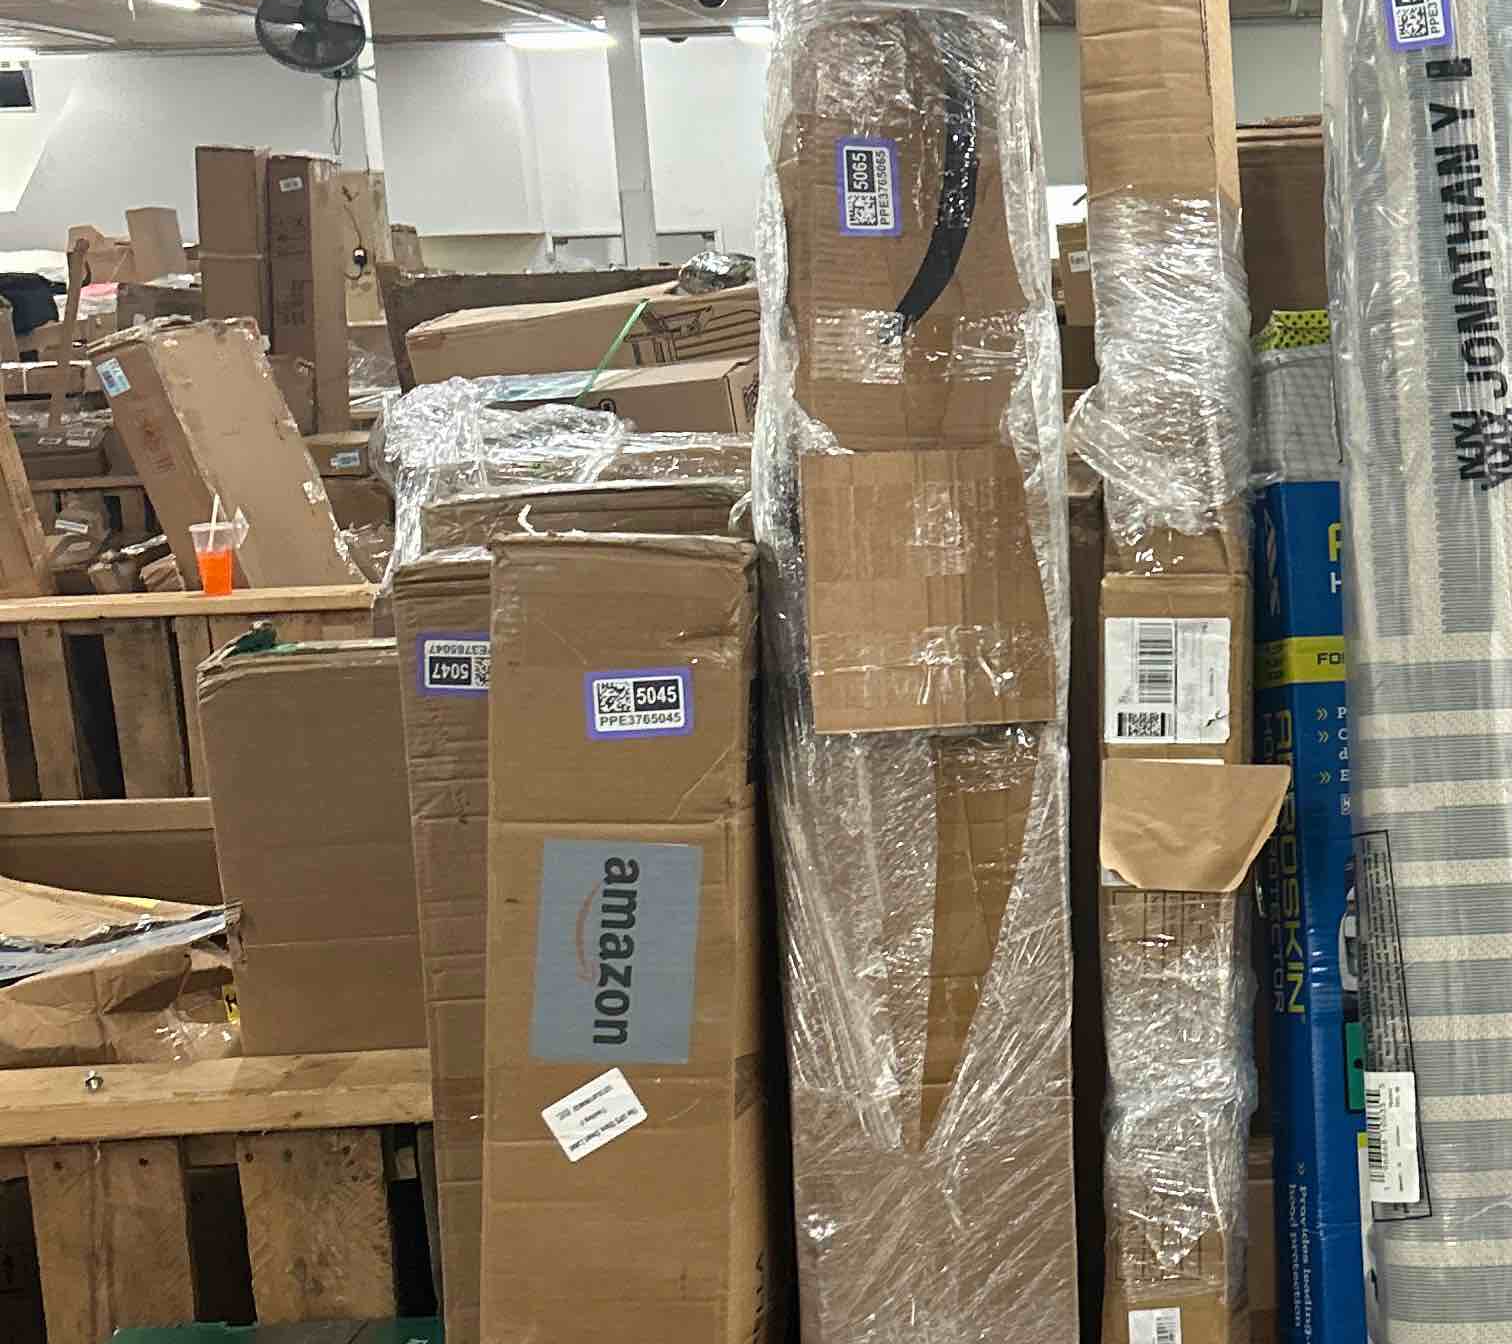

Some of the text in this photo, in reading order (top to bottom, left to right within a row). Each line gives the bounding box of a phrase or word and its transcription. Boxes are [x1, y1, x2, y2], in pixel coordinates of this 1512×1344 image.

[1429, 103, 1475, 134] Y
[853, 151, 869, 190] 5065
[879, 150, 891, 229] PPE3765065
[1437, 144, 1506, 401] JONATHAN
[429, 642, 491, 656] E3765047
[431, 660, 470, 680] 5047
[636, 684, 678, 706] 5045
[599, 712, 682, 727] PPE3765045
[592, 856, 641, 1047] amazon
